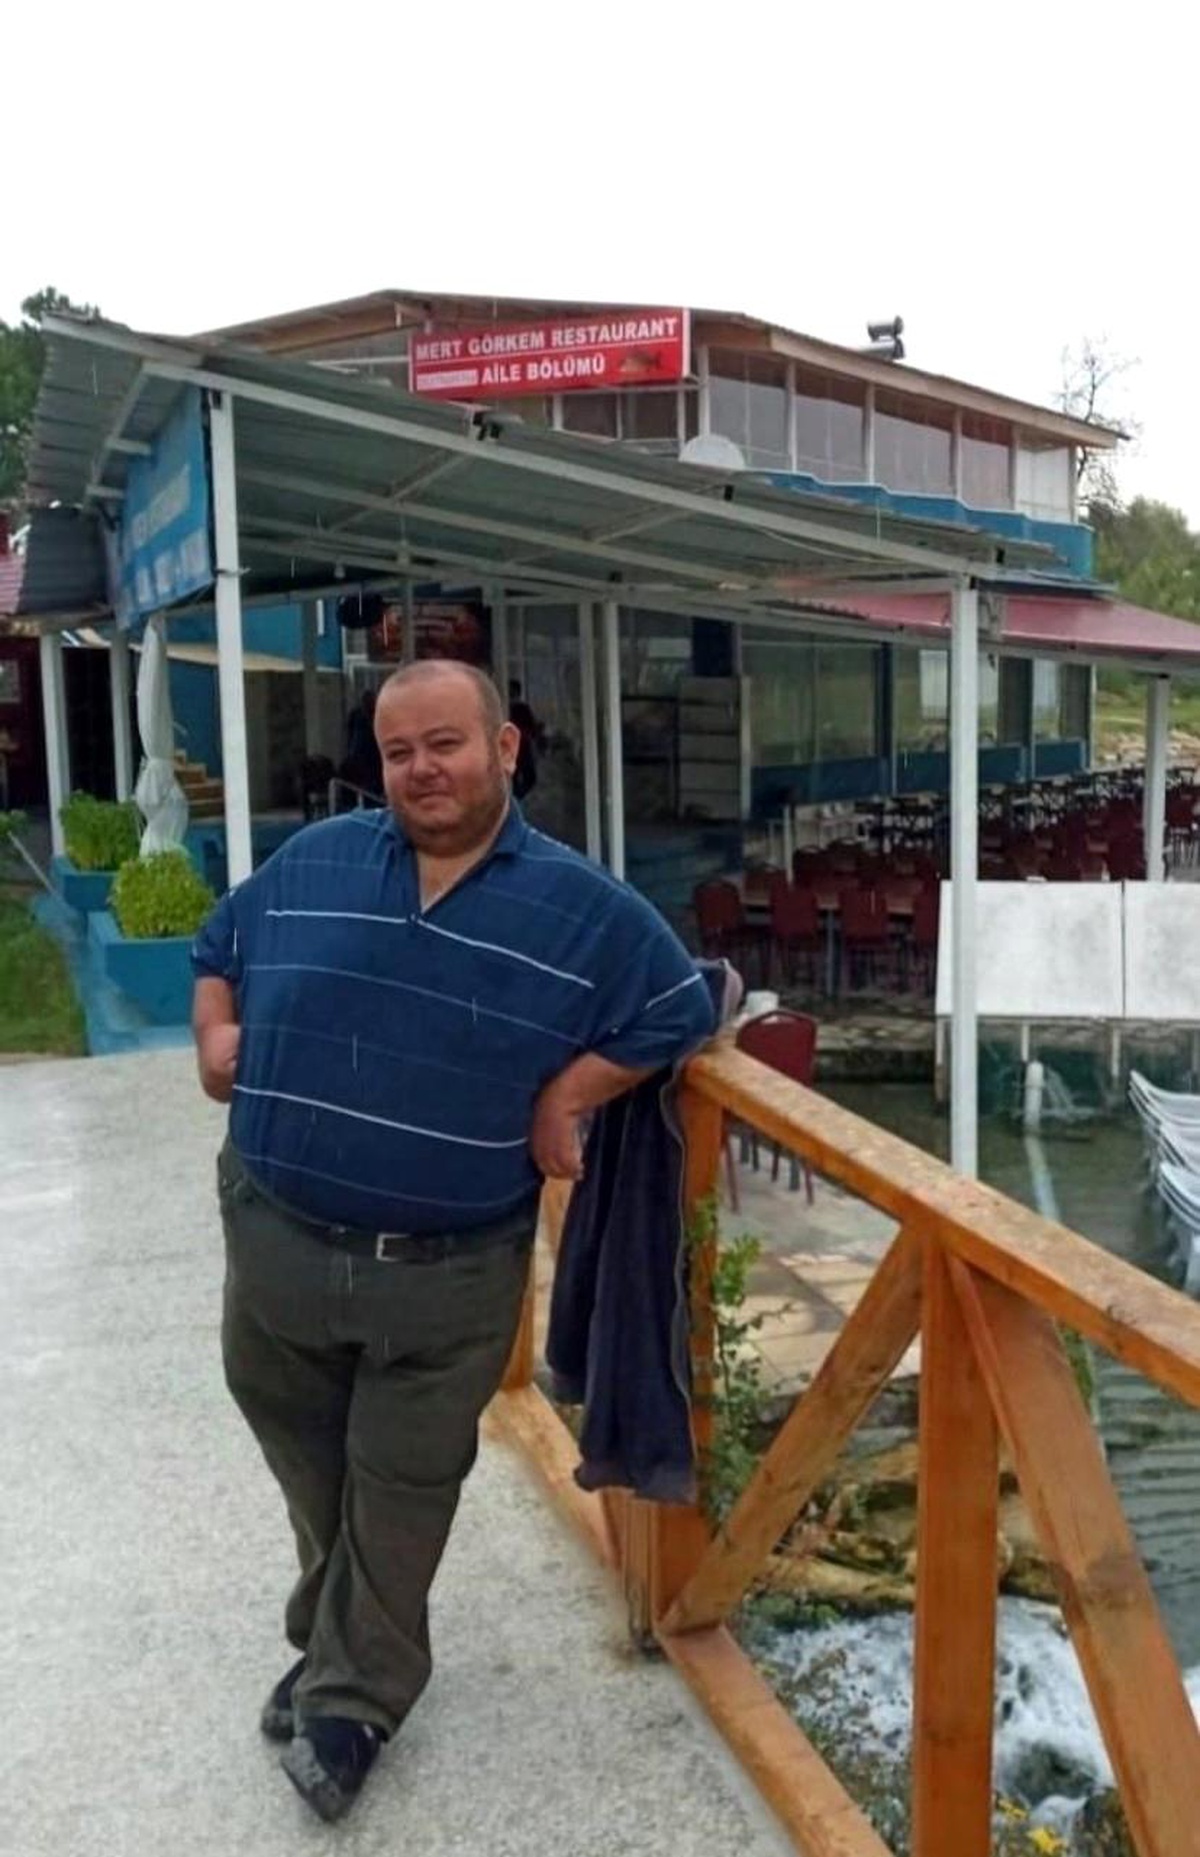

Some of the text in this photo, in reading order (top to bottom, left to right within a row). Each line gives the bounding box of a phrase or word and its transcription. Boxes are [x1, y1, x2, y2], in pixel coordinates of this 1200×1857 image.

[416, 318, 677, 361] MERT GÖRKEM RESTAURANT
[482, 363, 521, 385] AİLE
[527, 353, 605, 380] BÖLÜMÜ
